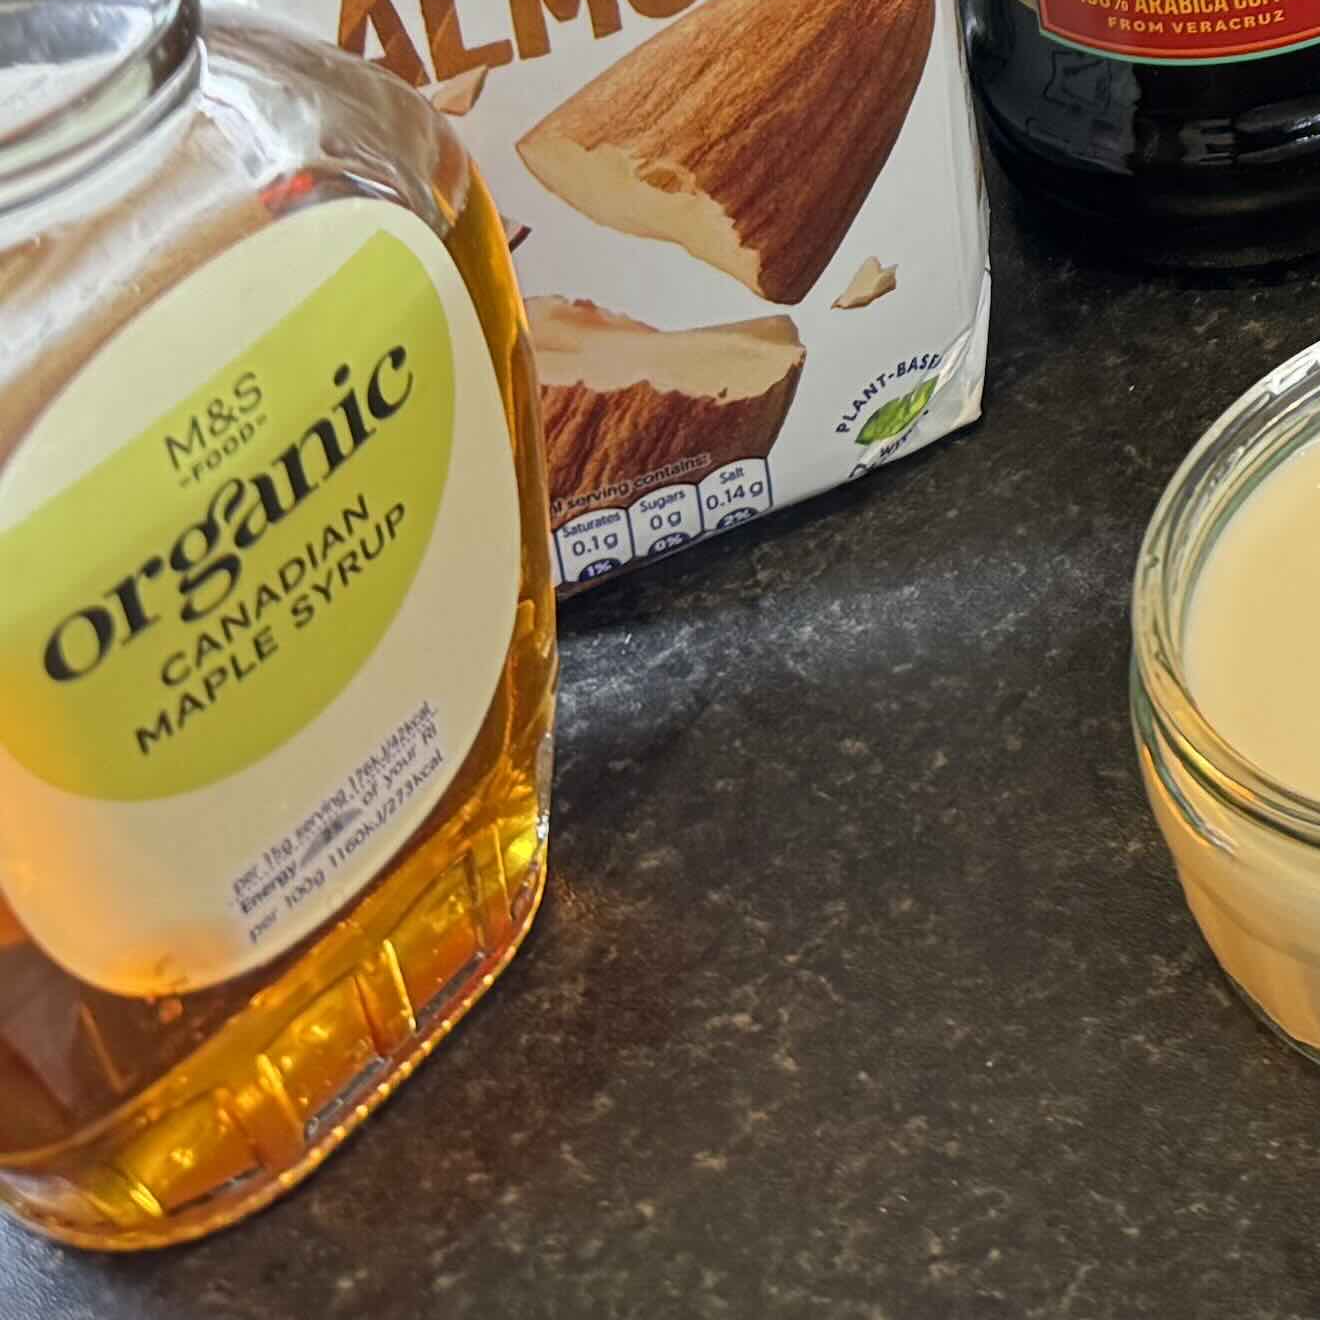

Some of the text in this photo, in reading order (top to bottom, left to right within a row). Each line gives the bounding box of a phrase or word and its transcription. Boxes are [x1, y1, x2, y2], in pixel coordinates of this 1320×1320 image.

[1107, 9, 1286, 35] FROM VERACRUZ
[163, 370, 264, 471] M&S
[718, 466, 745, 486] Salt
[566, 483, 631, 511] serving
[638, 488, 687, 514] Sugars
[704, 478, 765, 511] 0.14 g
[42, 344, 415, 684] organic
[561, 511, 622, 538] Saturates
[586, 558, 613, 578] 1%
[160, 492, 371, 689] CANADIAN
[133, 501, 407, 756] MAPLE SYRUP
[240, 860, 298, 914] Energy
[383, 744, 418, 790] your
[249, 910, 278, 944] per
[283, 867, 326, 909] 100g
